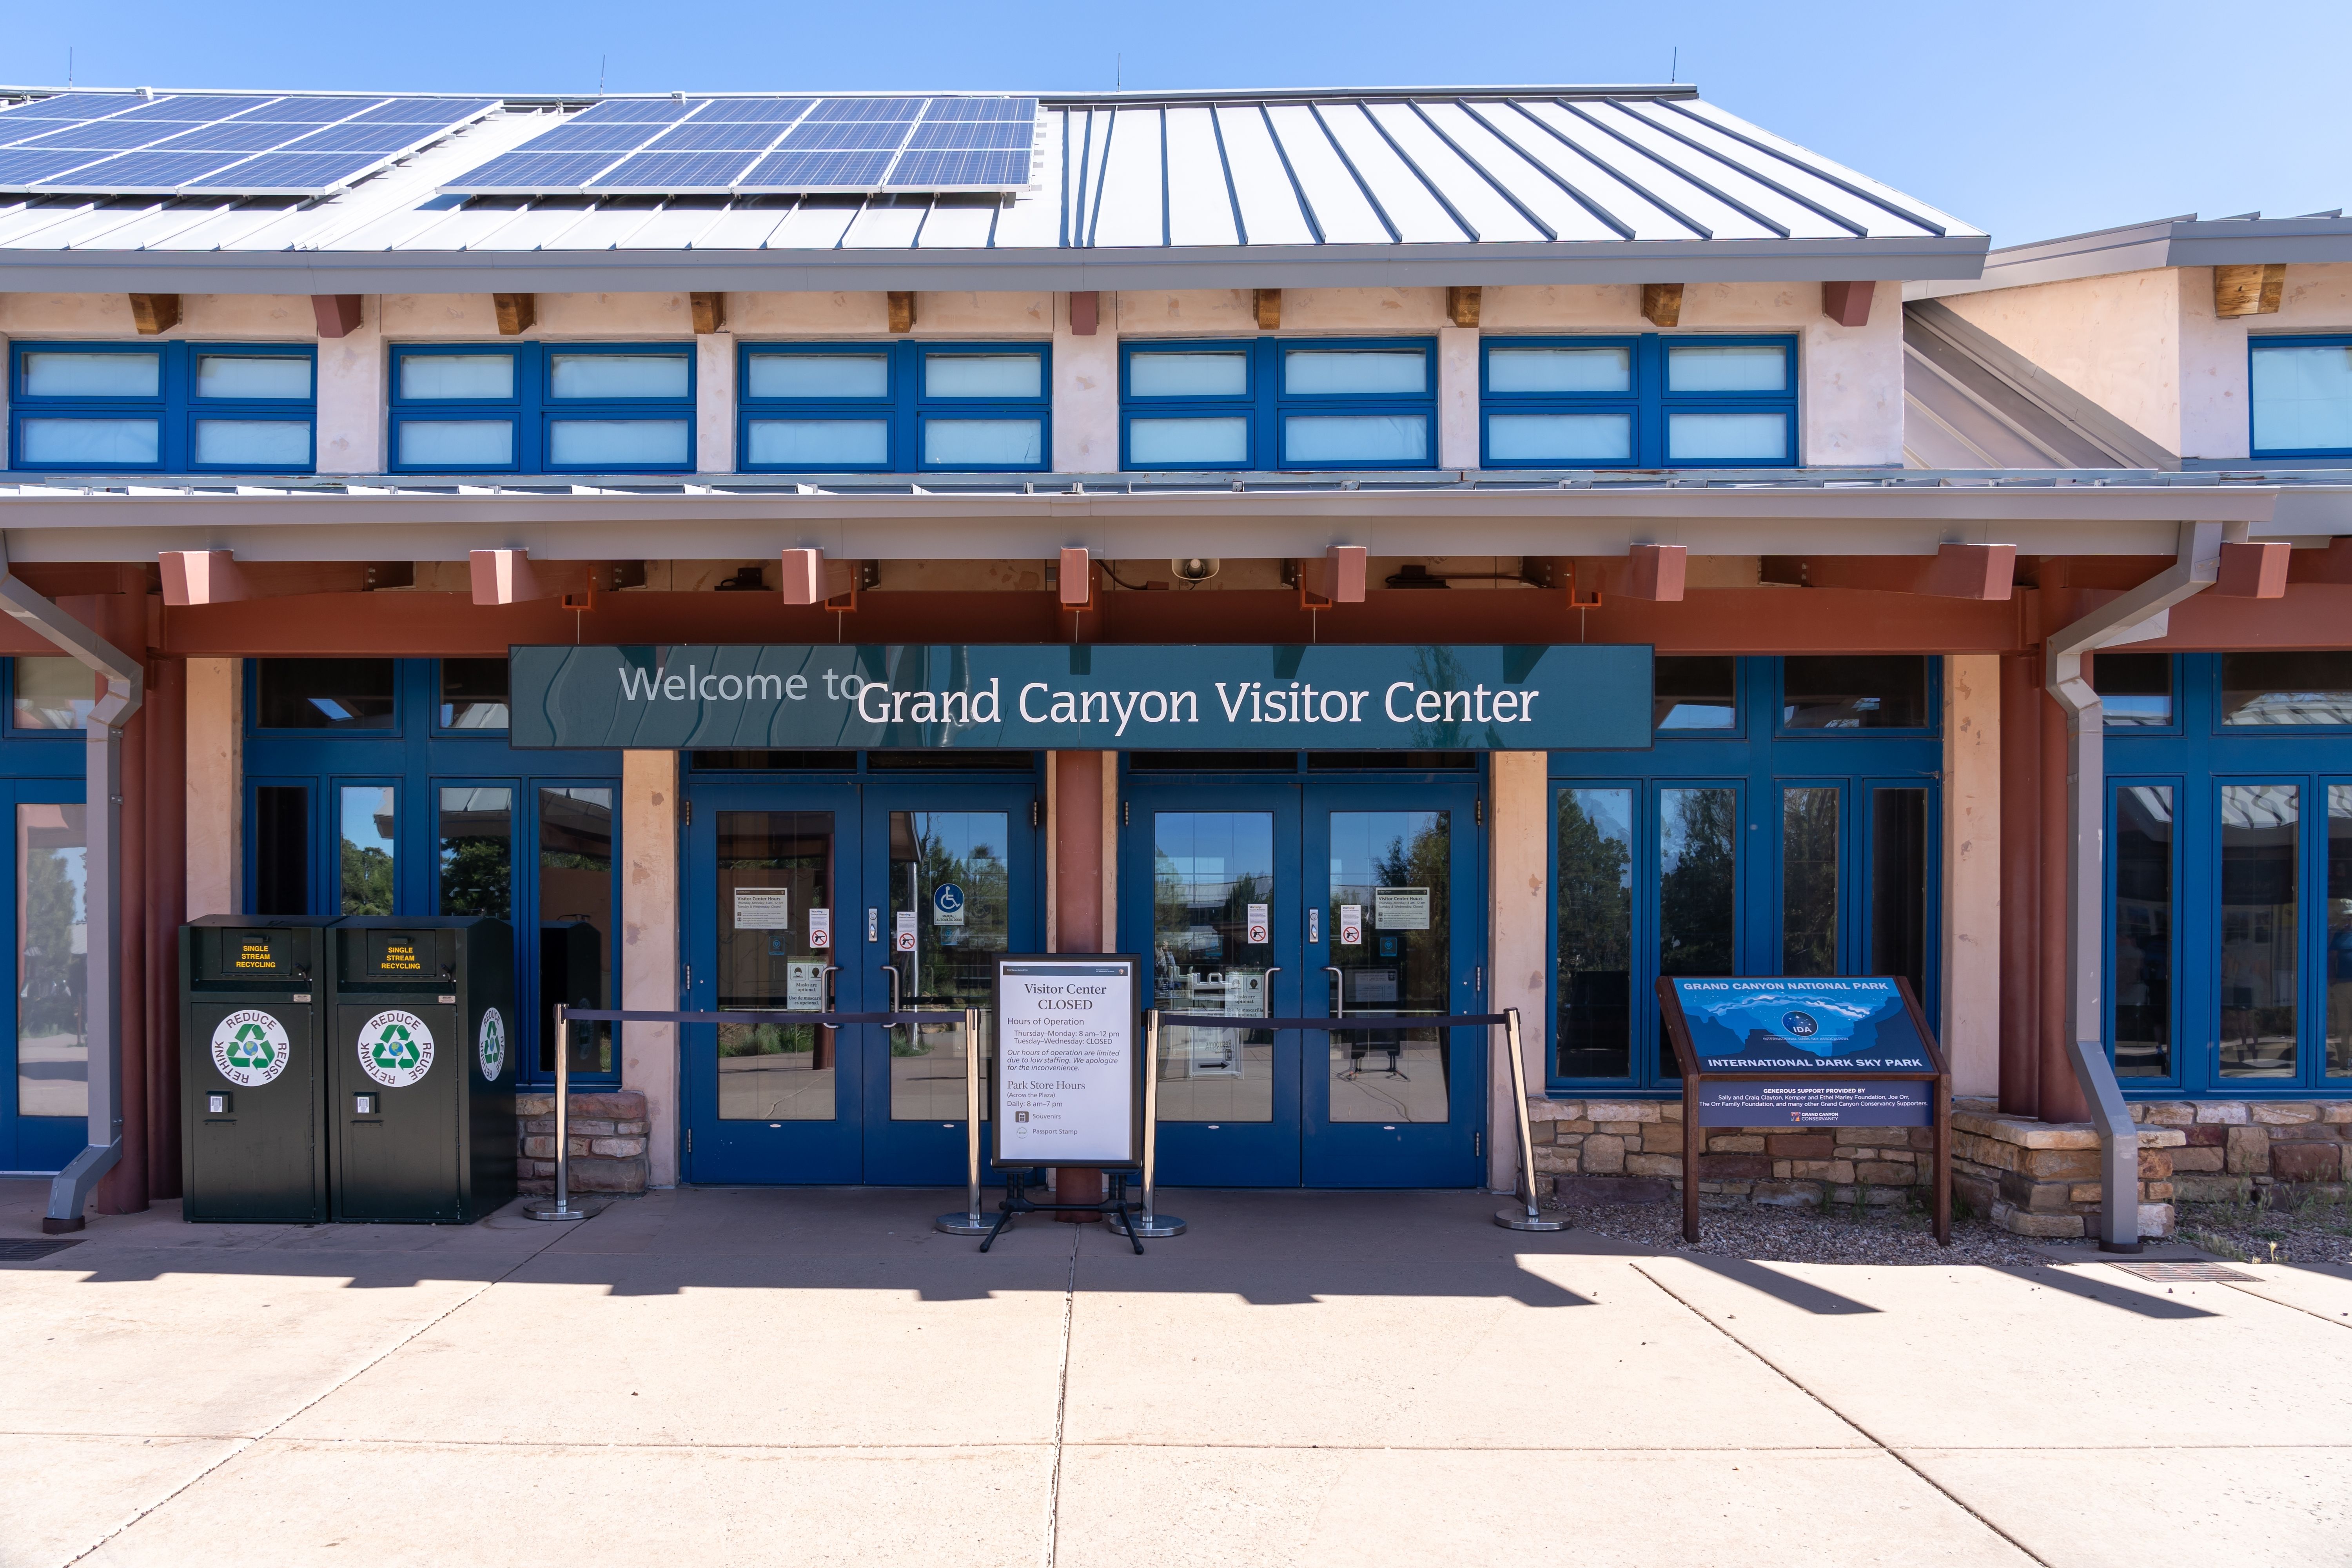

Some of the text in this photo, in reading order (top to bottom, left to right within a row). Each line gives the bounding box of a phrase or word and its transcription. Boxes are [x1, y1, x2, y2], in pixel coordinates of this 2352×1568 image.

[618, 664, 863, 701] Welcome to
[858, 677, 1539, 737] Grand Canyon Visitor Center
[1025, 984, 1106, 994] Visitor Center
[1038, 1000, 1092, 1009] CLOSED
[225, 1013, 277, 1030] REDUCE
[370, 1013, 421, 1031] REDUCE
[483, 1010, 500, 1027] REDUCE
[1044, 1018, 1083, 1026] Operation
[214, 1040, 249, 1084] RETHINK
[262, 1043, 287, 1081] REUSE
[360, 1042, 396, 1085] RETHINK
[408, 1042, 432, 1081] REUSE
[480, 1040, 492, 1079] RETHINK
[496, 1036, 504, 1073] REUSE
